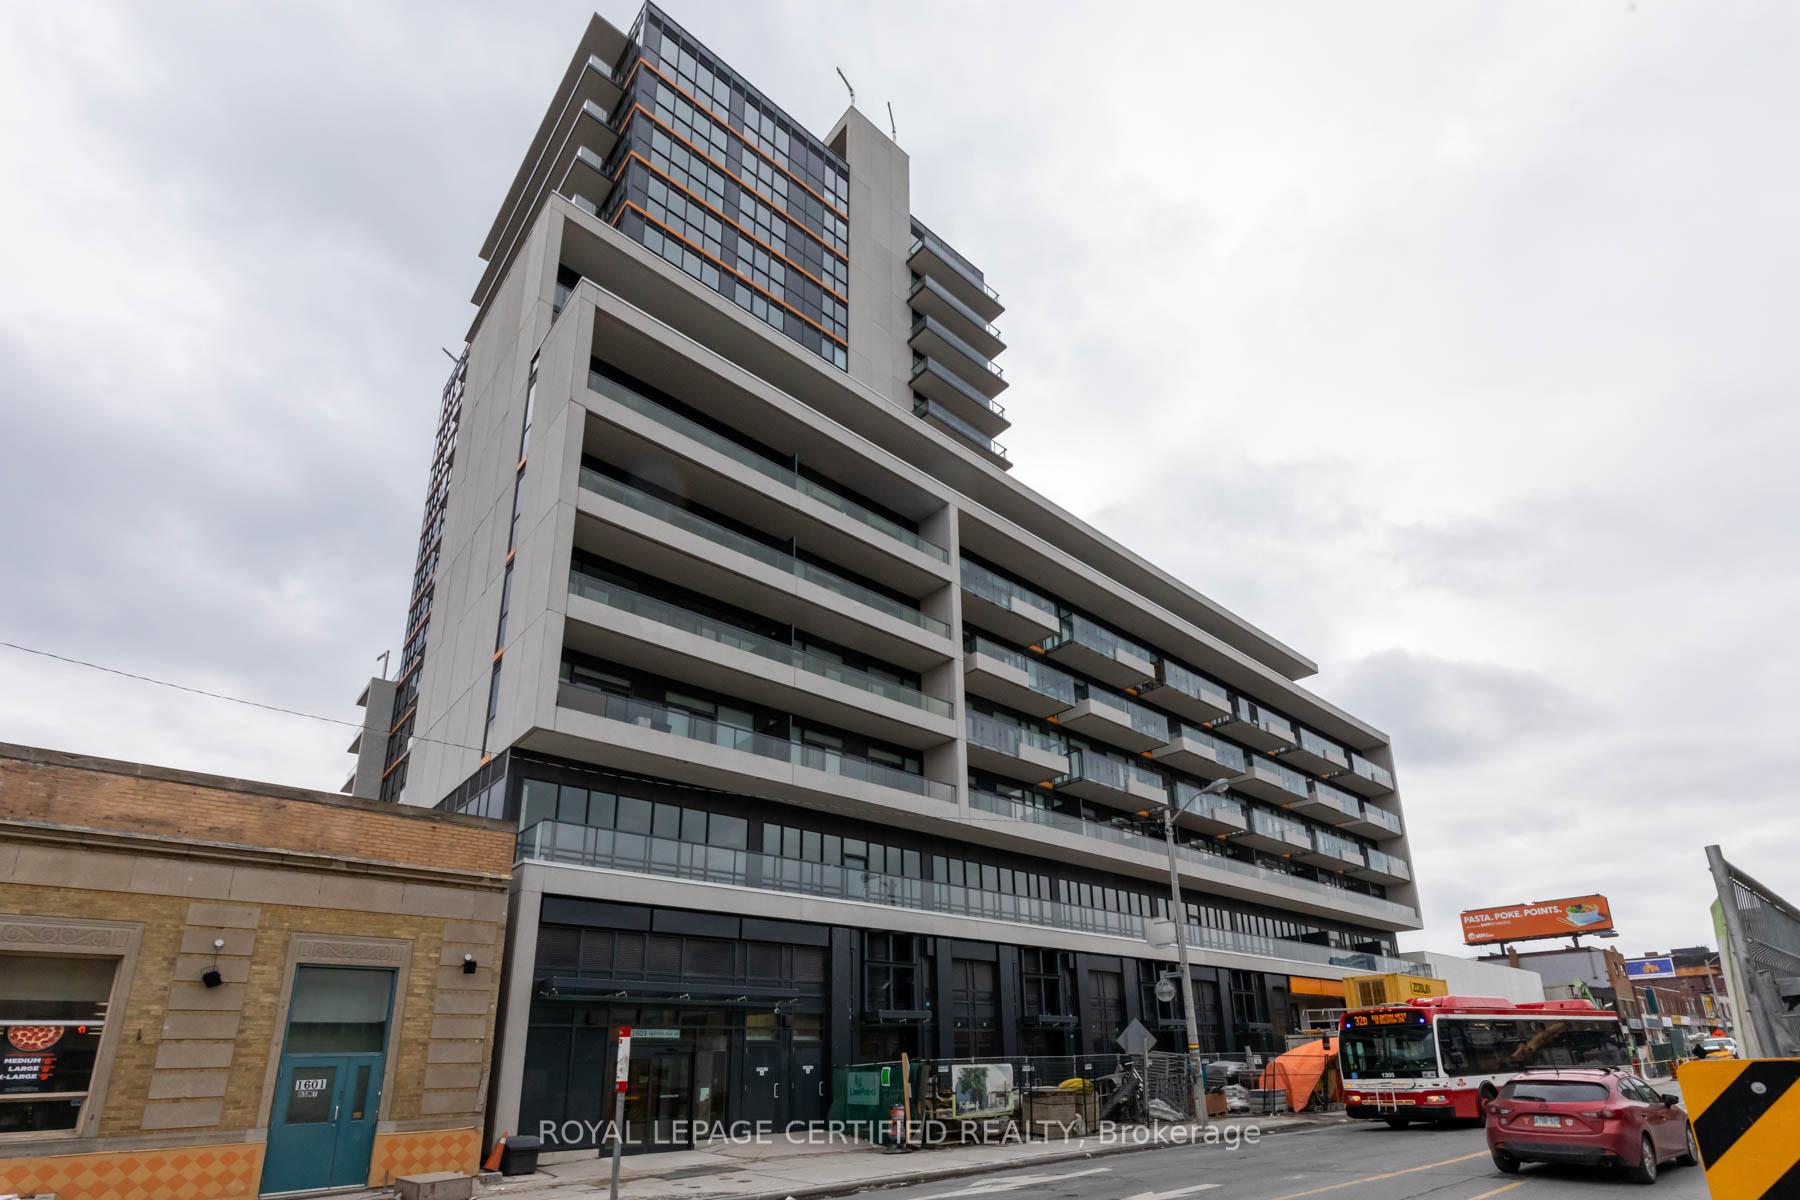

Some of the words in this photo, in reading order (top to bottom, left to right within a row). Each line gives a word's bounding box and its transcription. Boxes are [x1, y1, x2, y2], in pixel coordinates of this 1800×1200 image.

[1463, 913, 1494, 924] PASTA.
[1495, 910, 1523, 921] POKE.
[1523, 905, 1563, 917] POINTS.
[297, 1080, 324, 1090] 1601
